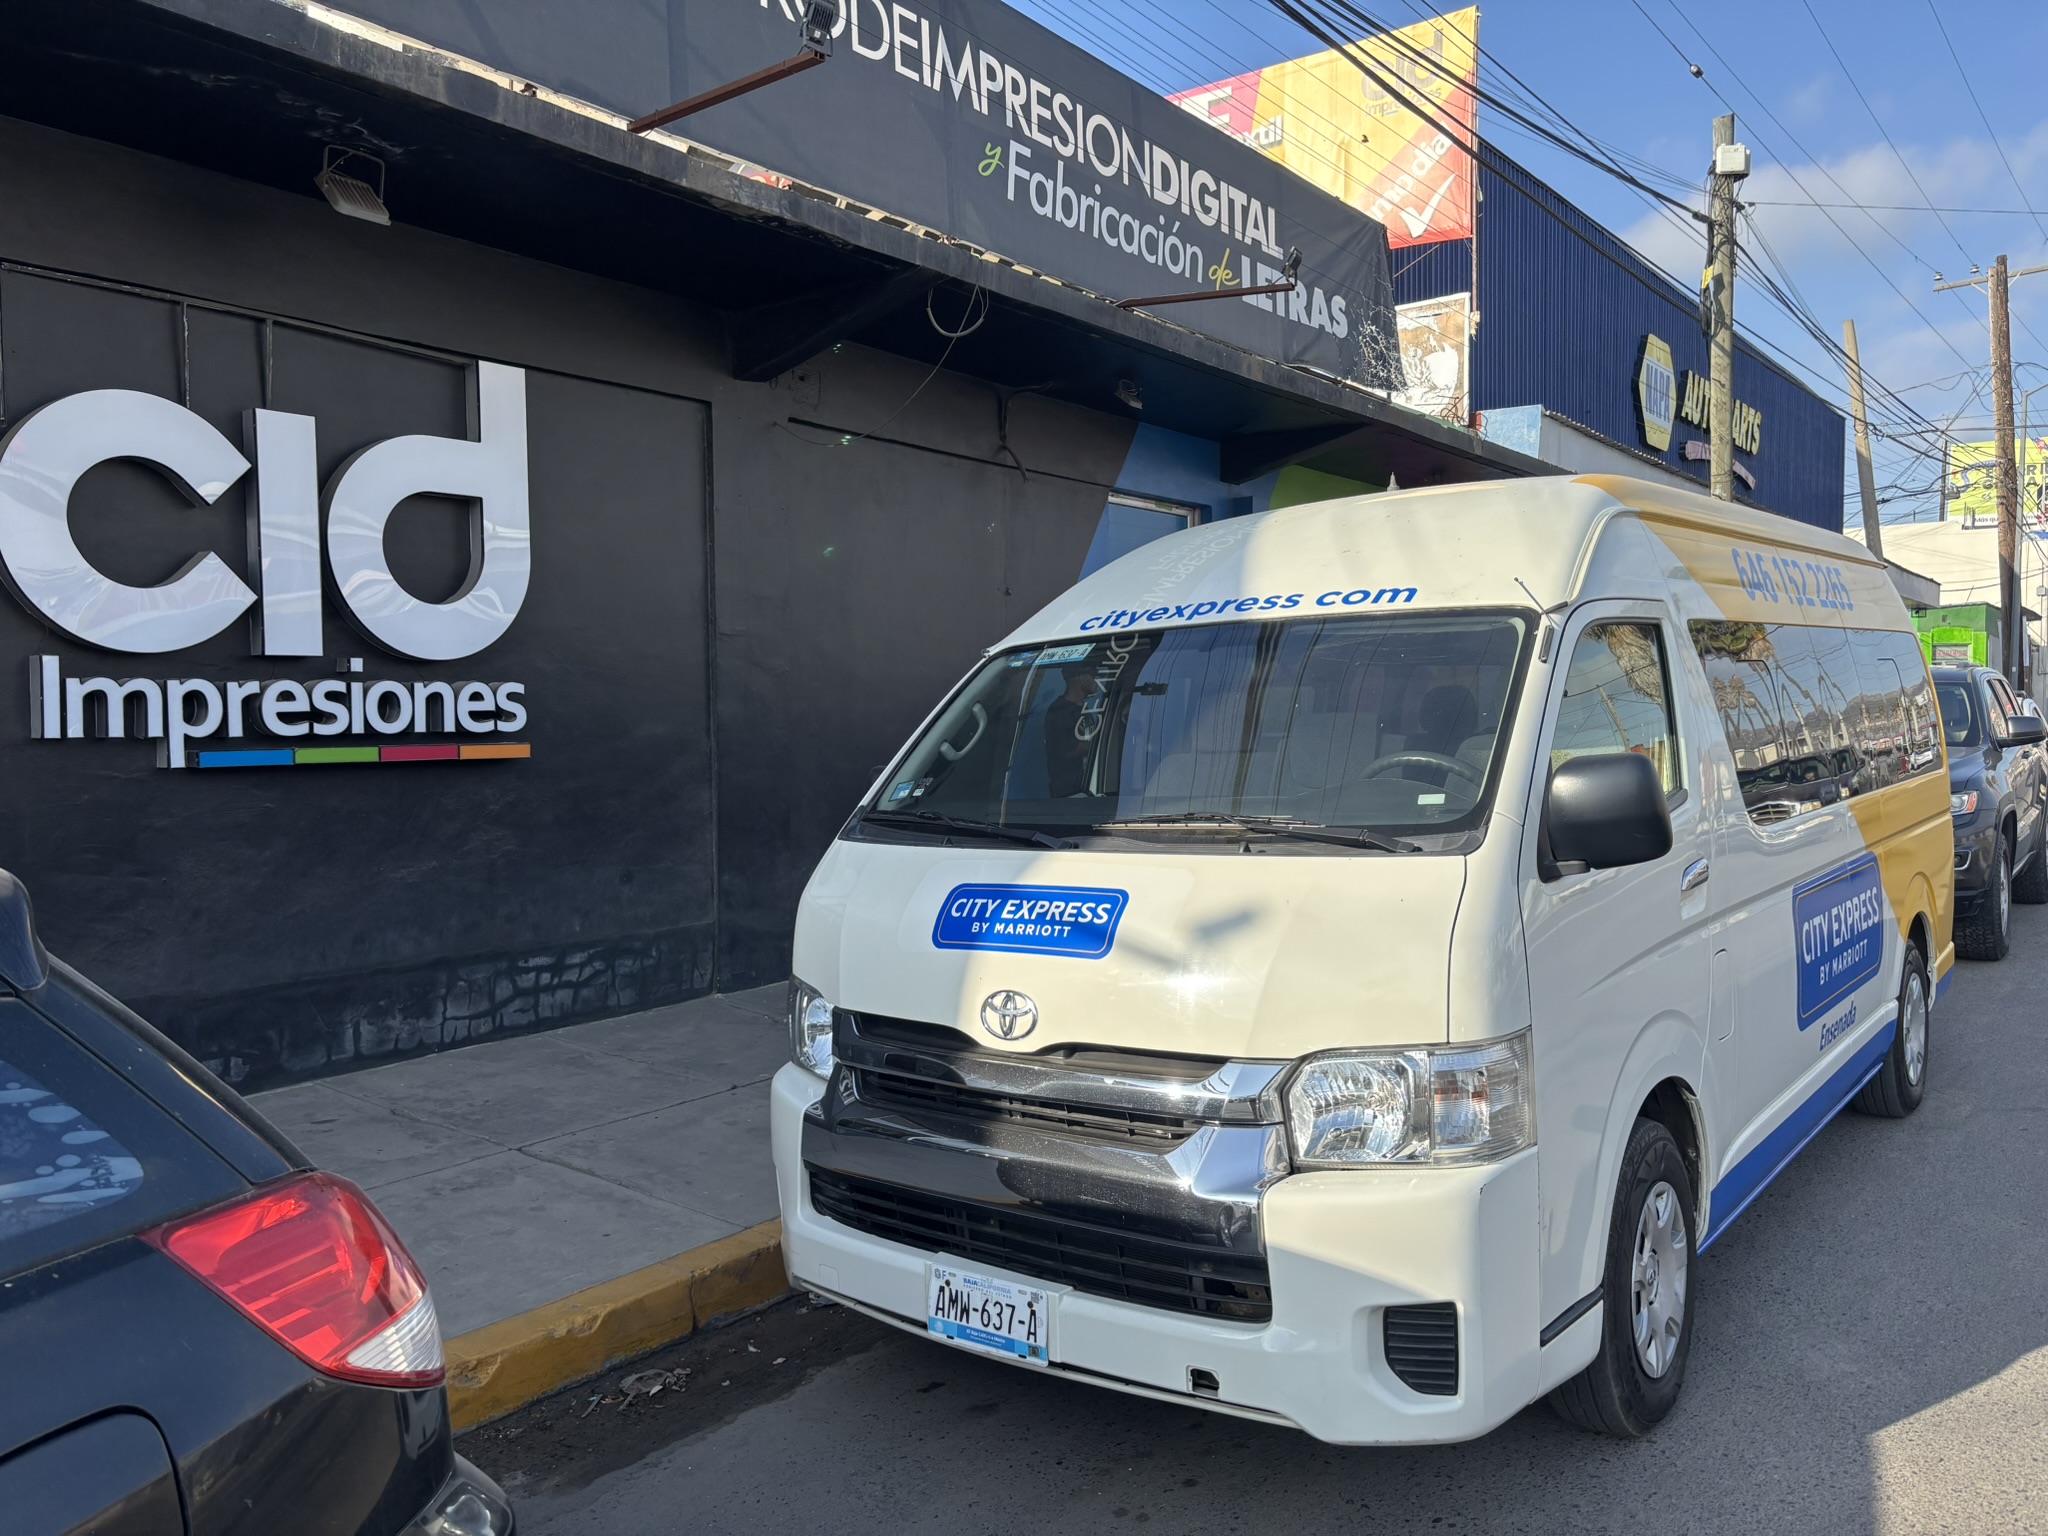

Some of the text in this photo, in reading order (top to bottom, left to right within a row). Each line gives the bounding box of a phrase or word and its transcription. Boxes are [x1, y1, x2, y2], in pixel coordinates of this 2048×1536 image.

[978, 139, 1348, 339] y Fabricación de LETRAS
[1645, 363, 1672, 424] NAPA
[1732, 547, 1779, 604] 646
[1771, 556, 1816, 607] 152
[1079, 586, 1419, 632] cityexpress com
[950, 898, 1112, 925] CITY EXPRESS
[971, 922, 1072, 938] BY MARRIOTT
[1802, 886, 1880, 964] CITY EXPRESS
[1819, 938, 1868, 986] BY MARRIOTT
[1819, 1000, 1857, 1052] Ensenada
[934, 1284, 1038, 1344] AMW-637-A
